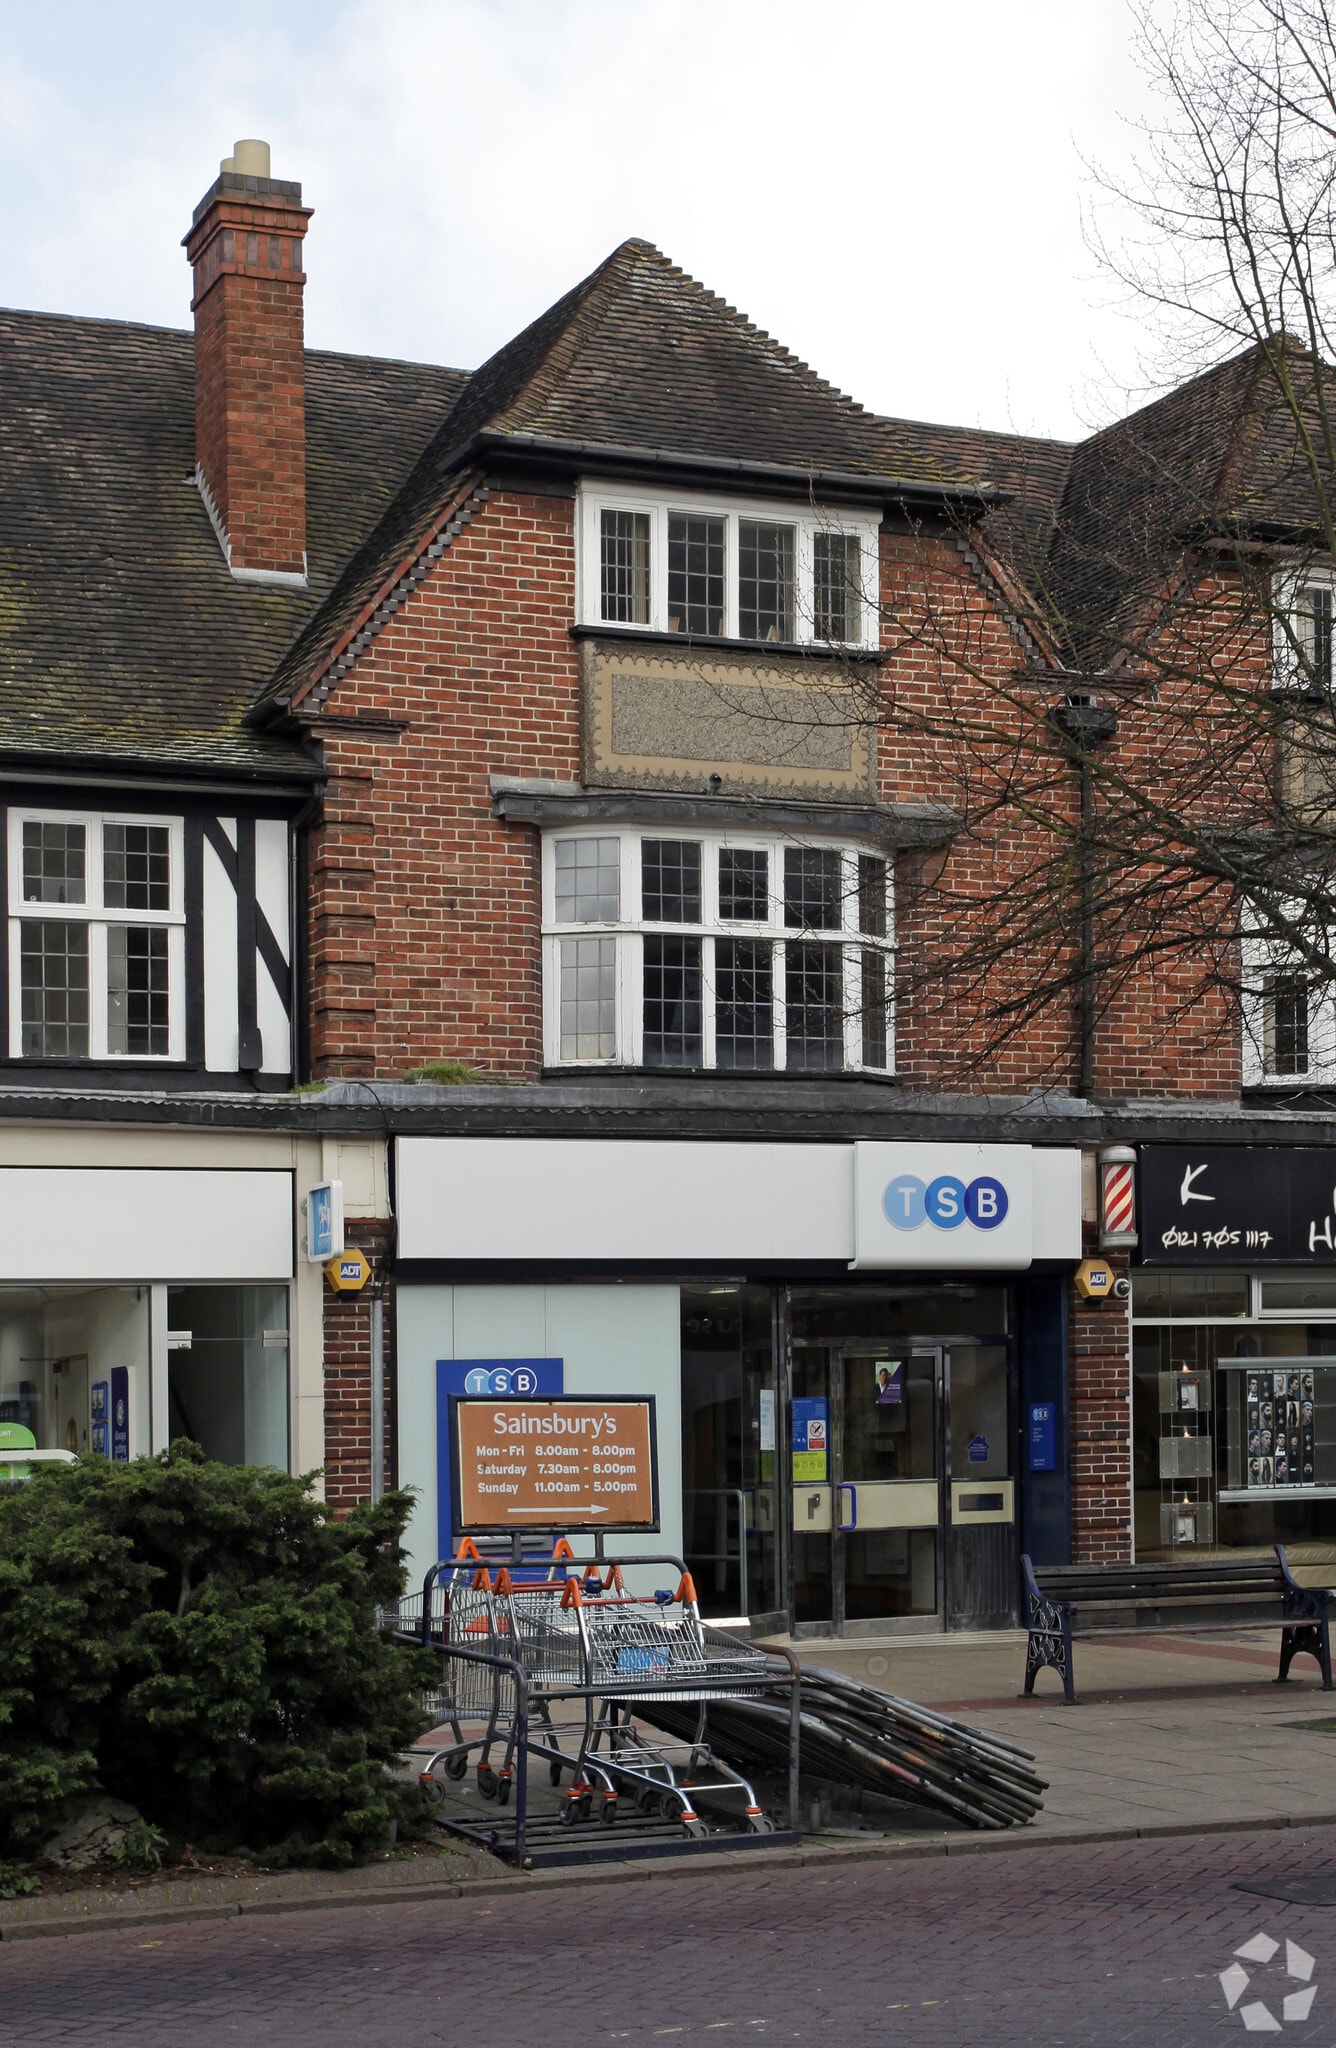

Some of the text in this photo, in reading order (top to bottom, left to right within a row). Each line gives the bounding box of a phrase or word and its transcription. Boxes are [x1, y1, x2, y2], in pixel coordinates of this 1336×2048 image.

[1180, 1163, 1217, 1207] K
[896, 1185, 1000, 1219] TSB
[1246, 1230, 1274, 1250] 1117
[1308, 1215, 1336, 1253] H
[340, 1265, 361, 1277] ADT
[1089, 1273, 1107, 1285] ADT
[472, 1374, 531, 1393] TSB
[493, 1412, 617, 1439] Sainsbury's
[476, 1445, 500, 1456] Mon
[509, 1445, 525, 1456] Fri
[534, 1445, 579, 1456] 8.00am
[592, 1445, 636, 1458] 8.00pm
[477, 1463, 527, 1476] Saturday
[537, 1463, 580, 1474] 7.30am
[592, 1463, 637, 1476] 8.00pm
[477, 1482, 519, 1494] Sunday
[534, 1481, 581, 1492] 11.00am
[593, 1481, 637, 1494] 5.00pm
